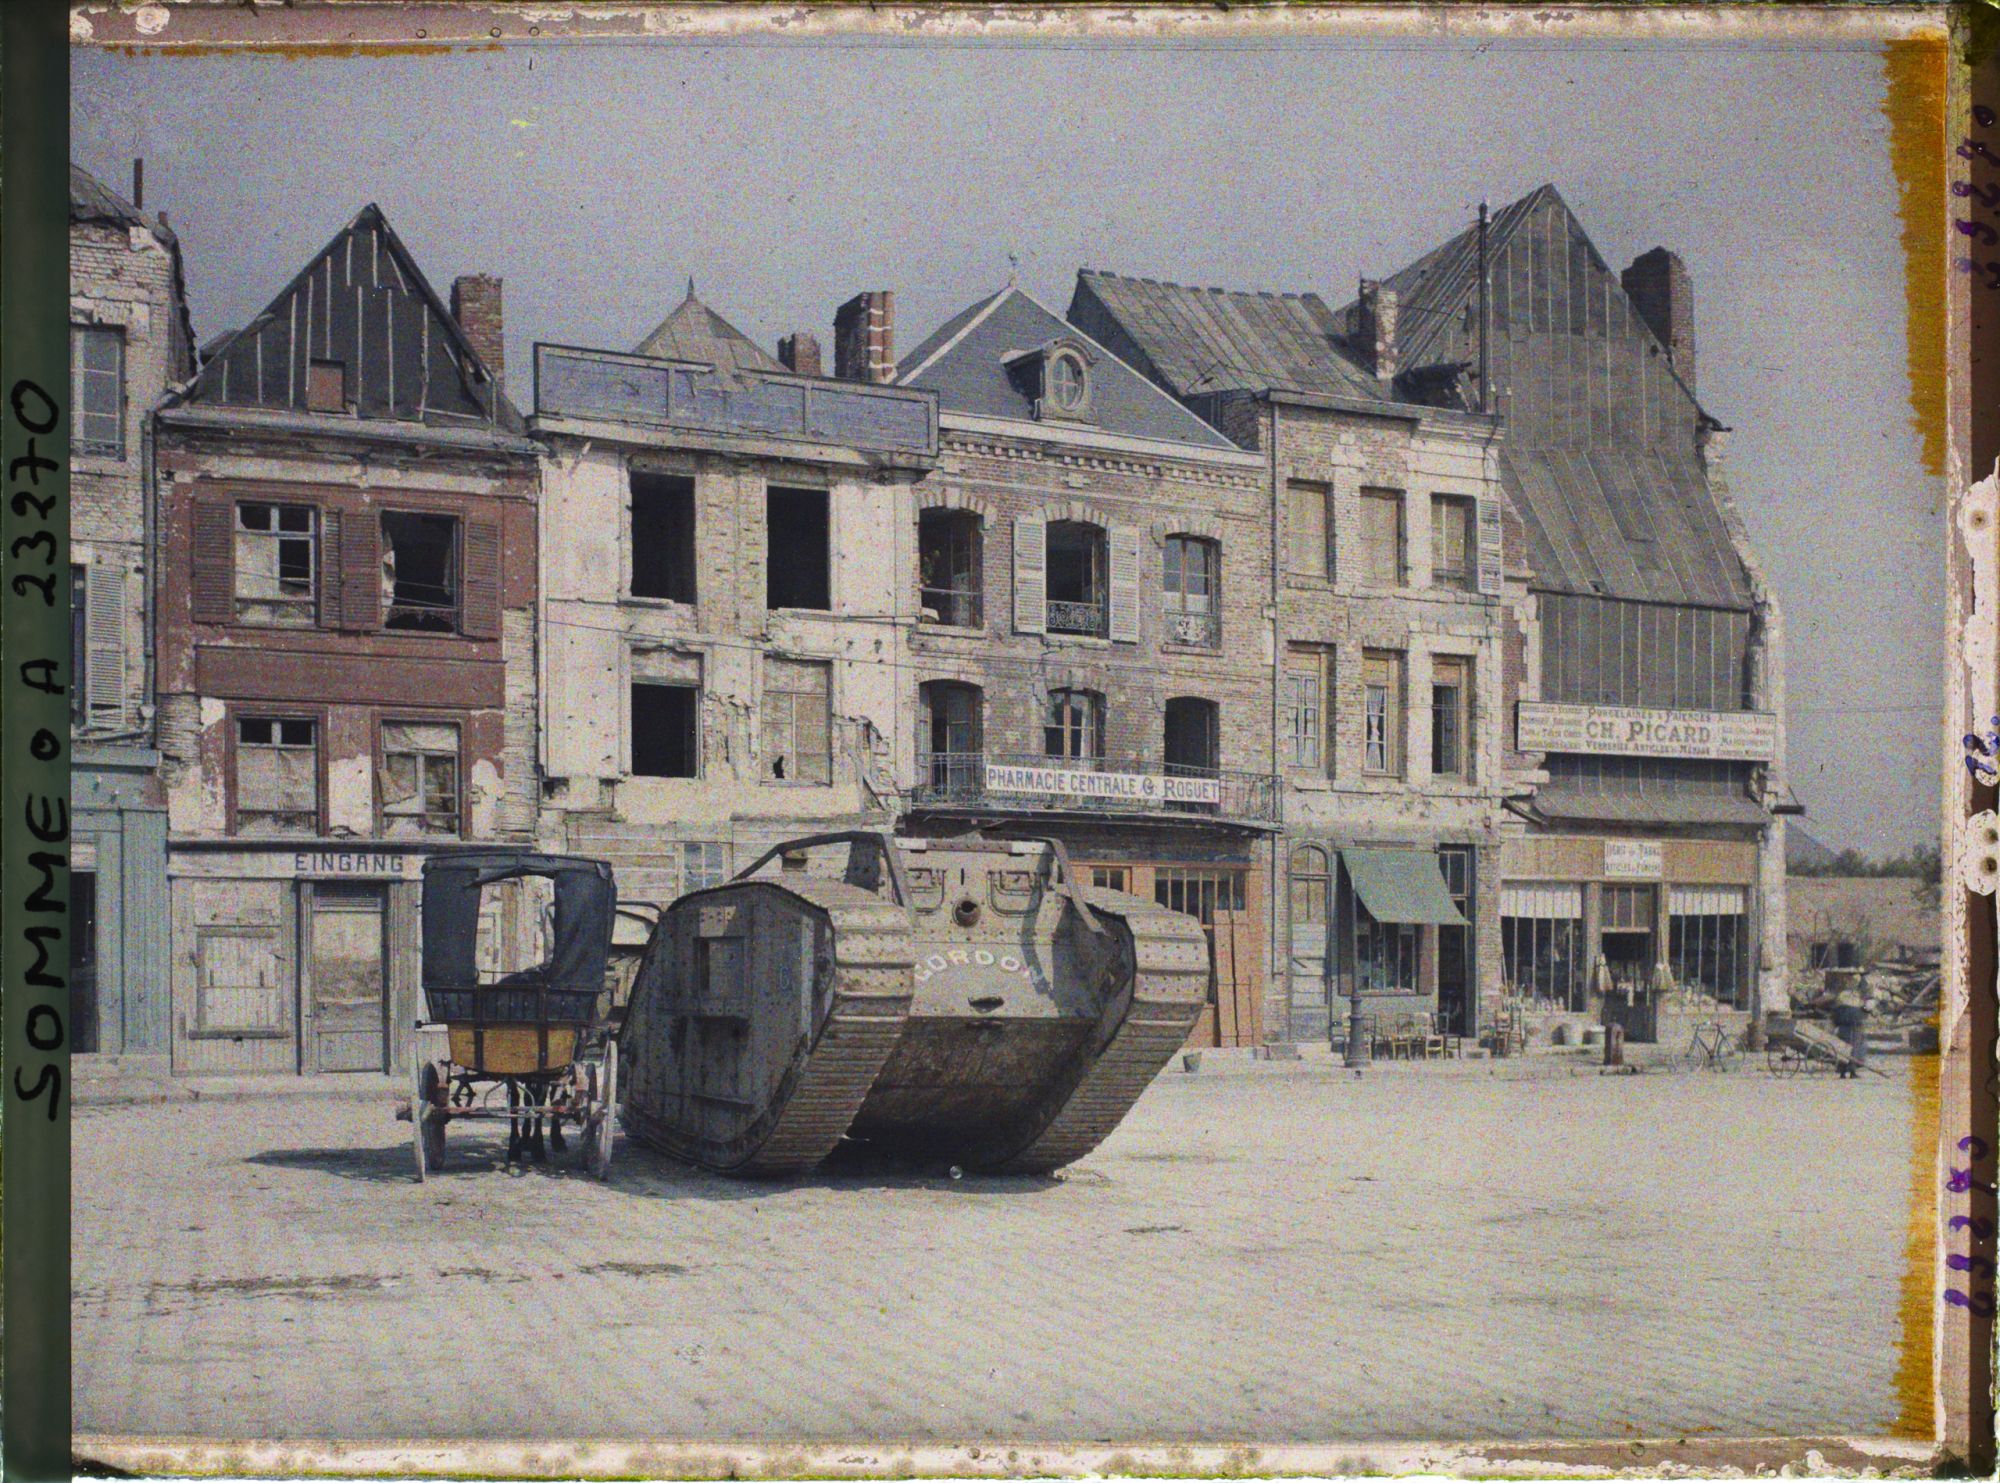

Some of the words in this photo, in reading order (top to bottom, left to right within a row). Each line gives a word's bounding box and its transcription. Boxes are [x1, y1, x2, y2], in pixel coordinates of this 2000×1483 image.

[11, 379, 59, 607] 23270
[20, 658, 65, 695] A
[1626, 720, 1711, 744] PICARD
[988, 768, 1065, 792] PHARMACIE
[1070, 774, 1137, 796] CENTRALE
[1162, 778, 1219, 800] ROGUET
[295, 852, 404, 873] EINGANG
[14, 793, 68, 1122] SOMME
